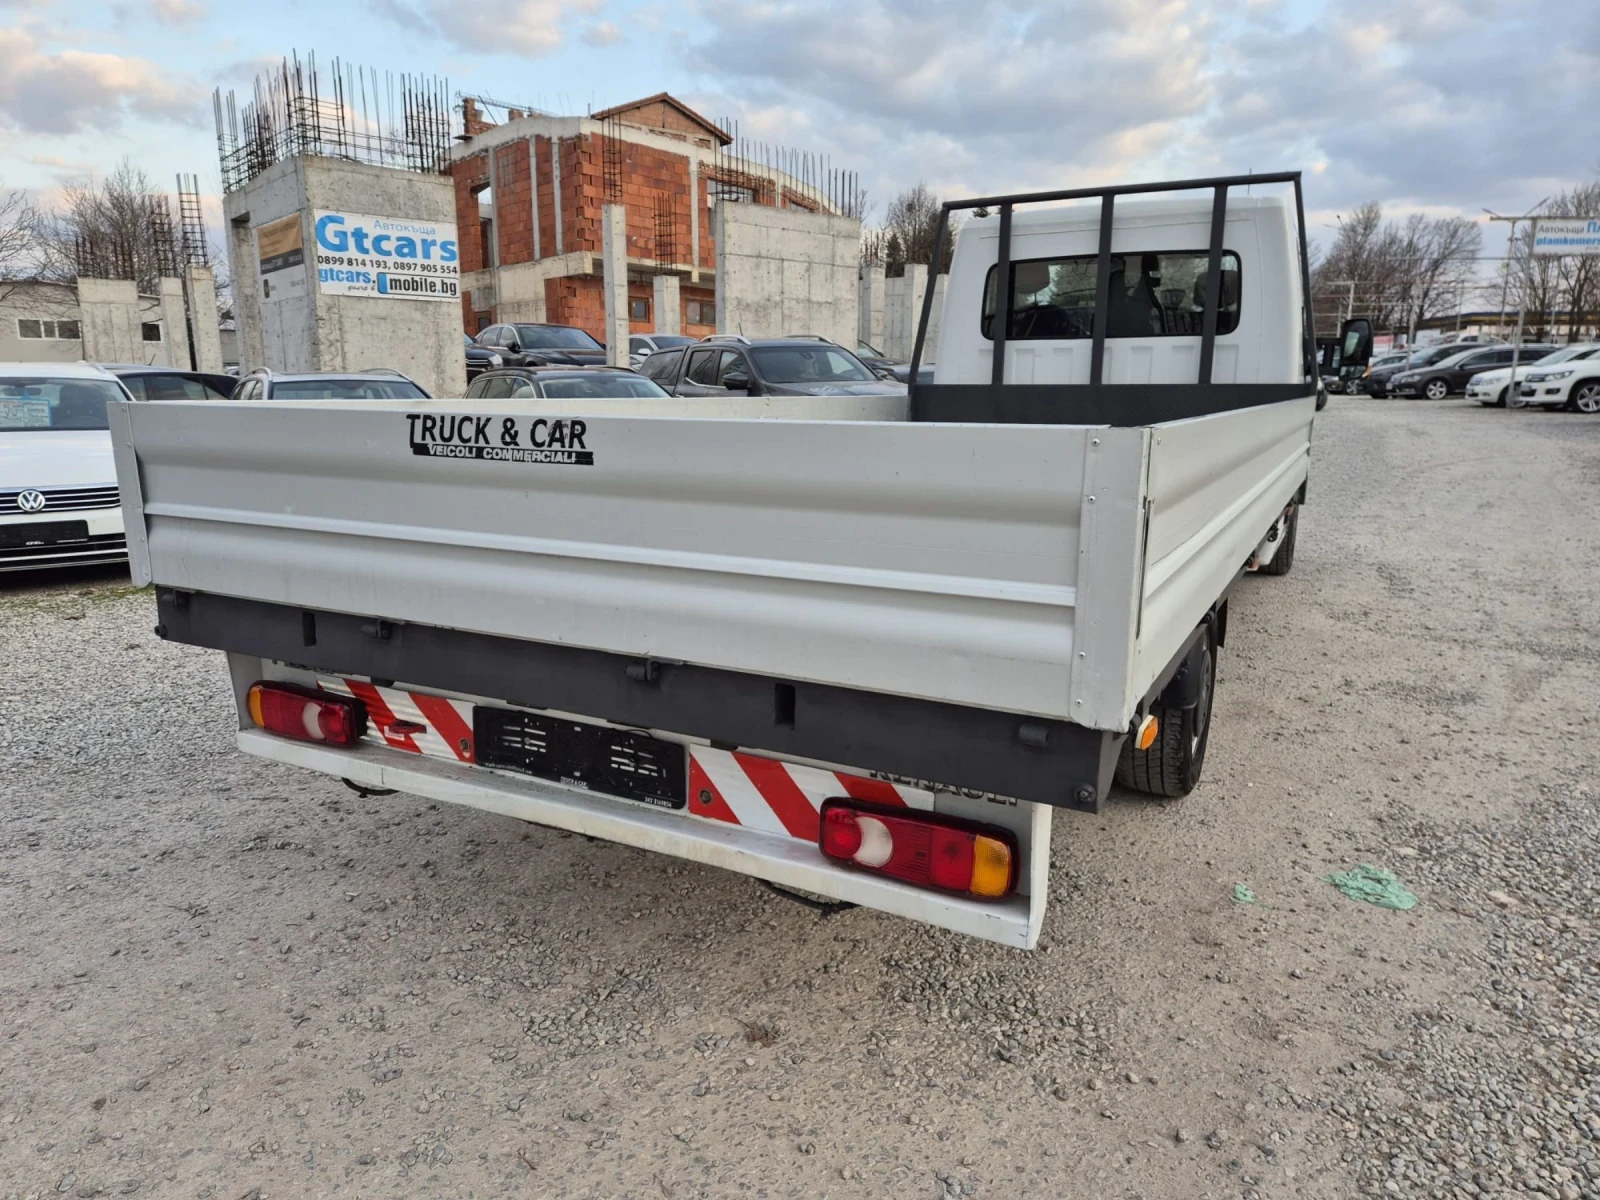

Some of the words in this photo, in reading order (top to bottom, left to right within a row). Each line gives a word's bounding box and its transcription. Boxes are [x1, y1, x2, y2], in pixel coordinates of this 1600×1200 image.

[373, 219, 436, 235] Автокъща
[315, 214, 458, 262] Gtcars
[317, 255, 344, 265] 0899
[346, 257, 367, 267] 814
[369, 259, 391, 270] 193,
[393, 261, 418, 271] 0897
[420, 263, 438, 273] 905
[440, 265, 458, 275] 554
[406, 413, 492, 448] TRUCK
[500, 417, 520, 447] &
[530, 418, 587, 449] CAR
[427, 443, 477, 458] VEICOLI
[482, 446, 577, 464] COMMERCIALI
